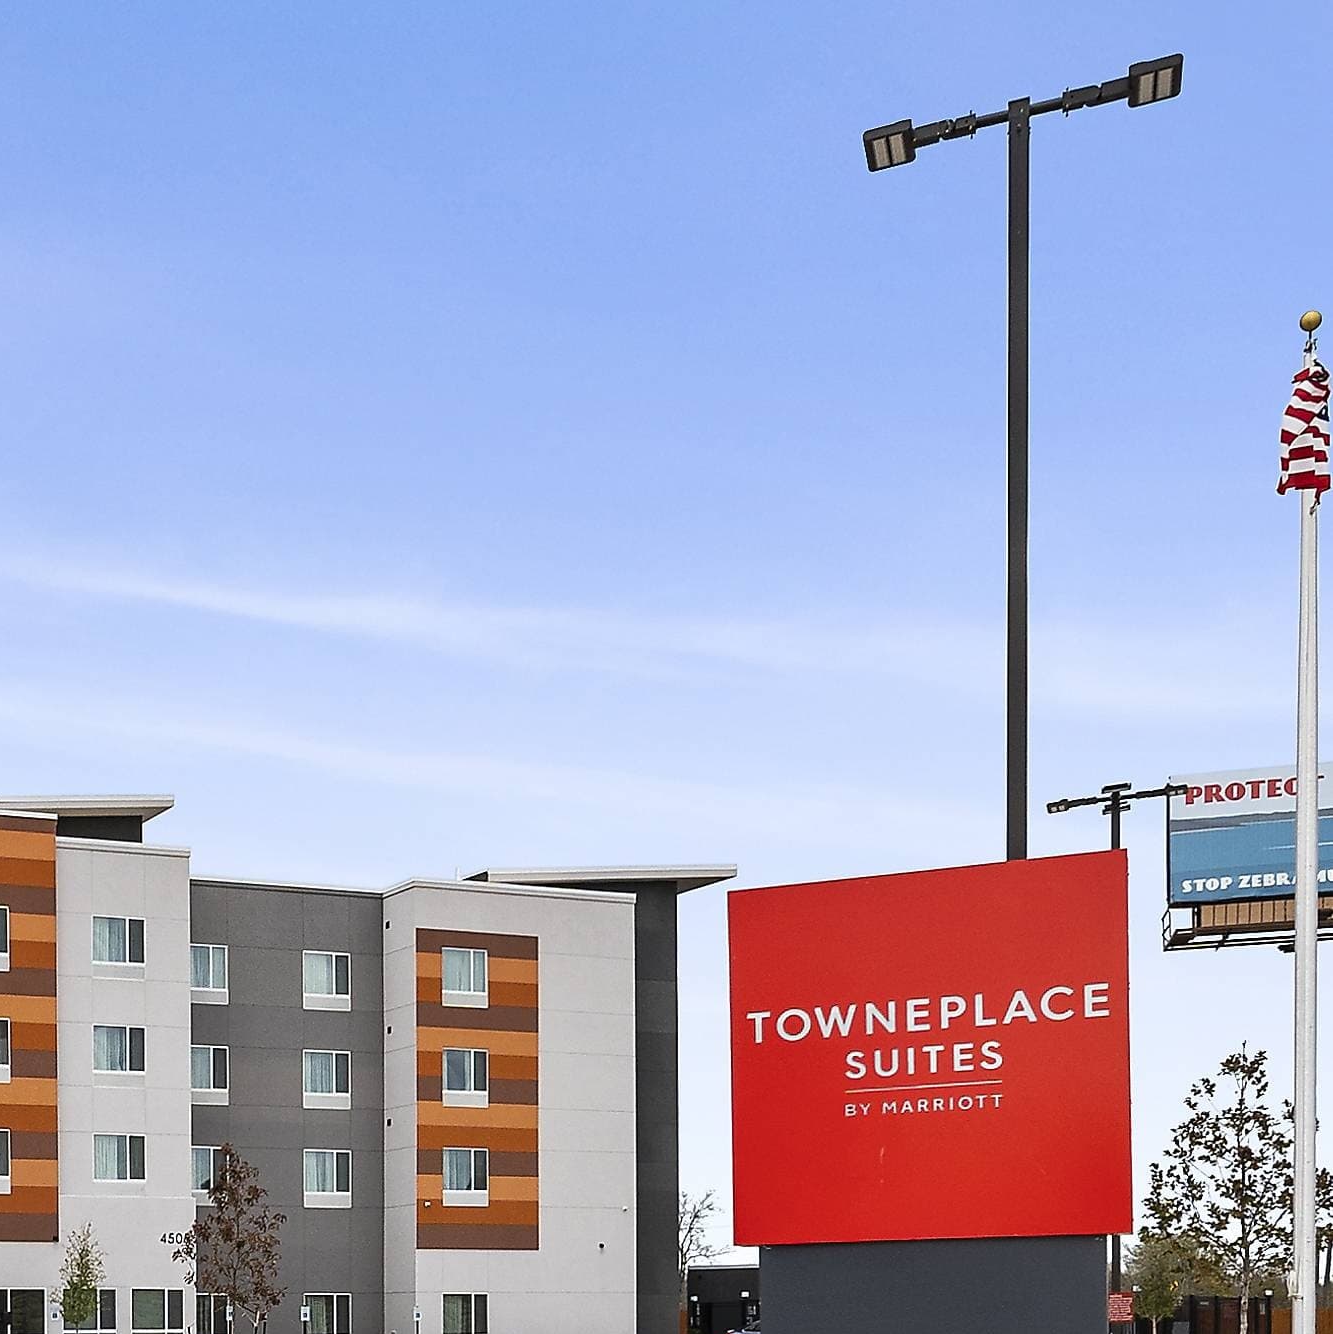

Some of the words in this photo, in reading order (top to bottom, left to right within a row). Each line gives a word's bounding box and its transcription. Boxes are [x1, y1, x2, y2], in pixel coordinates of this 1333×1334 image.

[1185, 775, 1325, 805] PROTEC
[1181, 876, 1233, 893] STOP
[746, 983, 1111, 1044] TOWNEPLACE
[844, 1041, 1004, 1080] SUITES
[844, 1103, 872, 1117] BY
[882, 1094, 1004, 1115] MARRIOTT
